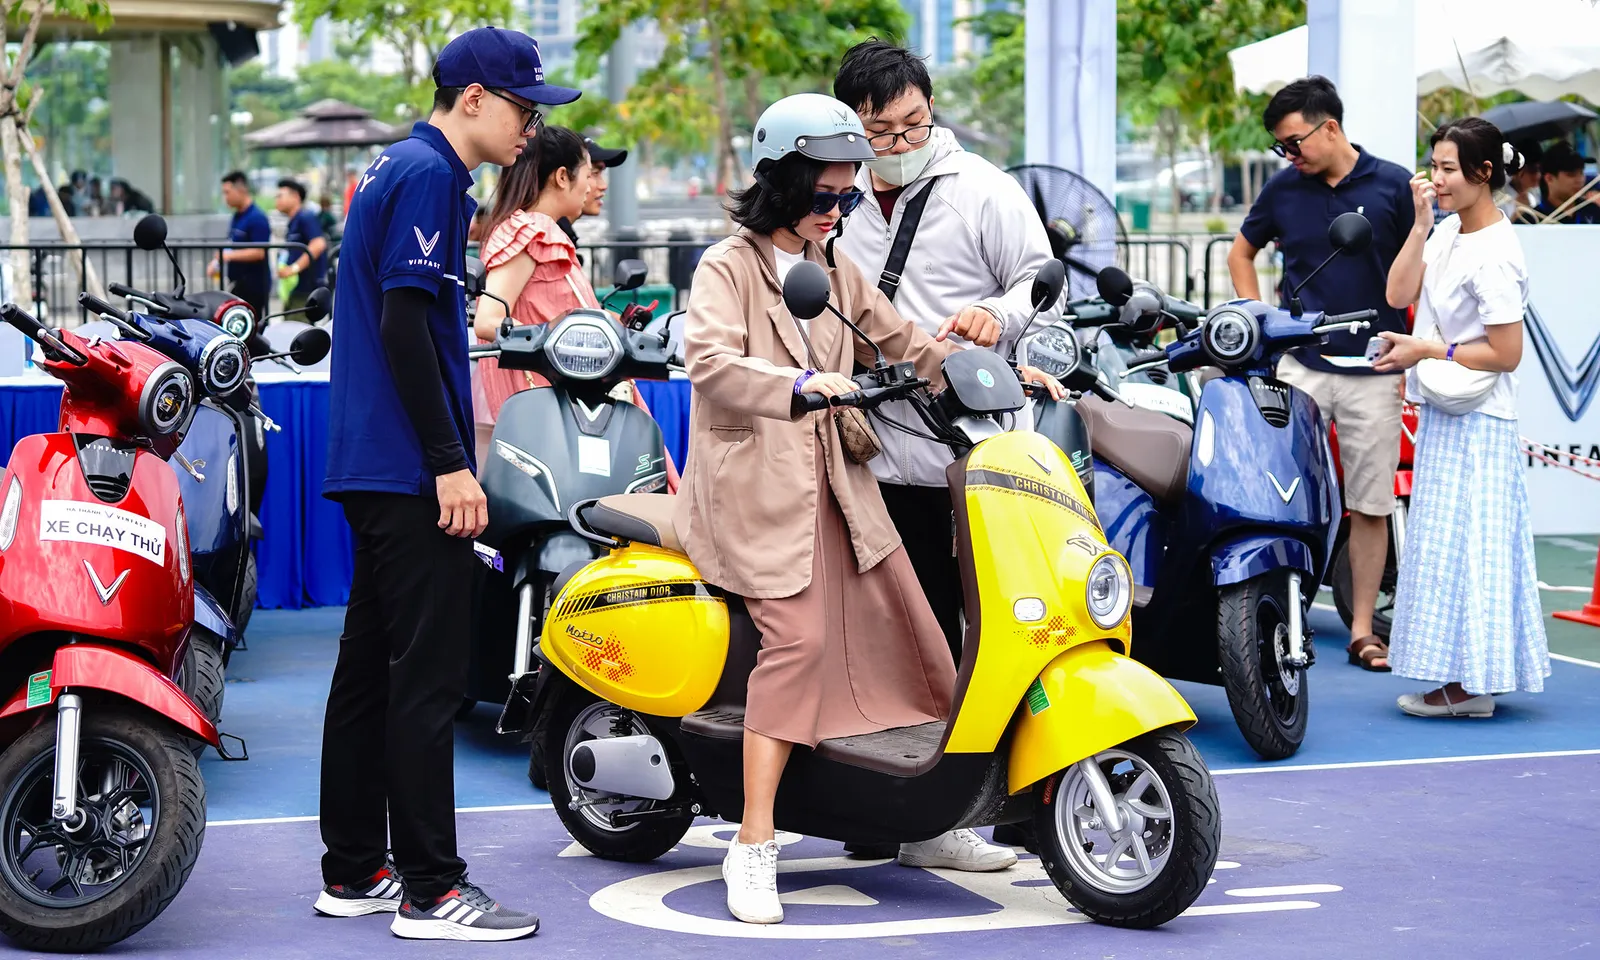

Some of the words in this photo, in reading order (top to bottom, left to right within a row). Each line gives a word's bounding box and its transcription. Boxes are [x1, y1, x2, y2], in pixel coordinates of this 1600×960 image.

[408, 259, 440, 269] VINFAST
[85, 443, 129, 457] VINFAST
[1015, 478, 1072, 506] CHRISTAIN
[46, 520, 70, 533] XE
[76, 522, 126, 542] CHẠY
[131, 532, 161, 556] THỬ
[606, 588, 648, 603] CHRISTAIN
[650, 585, 671, 597] DIOR
